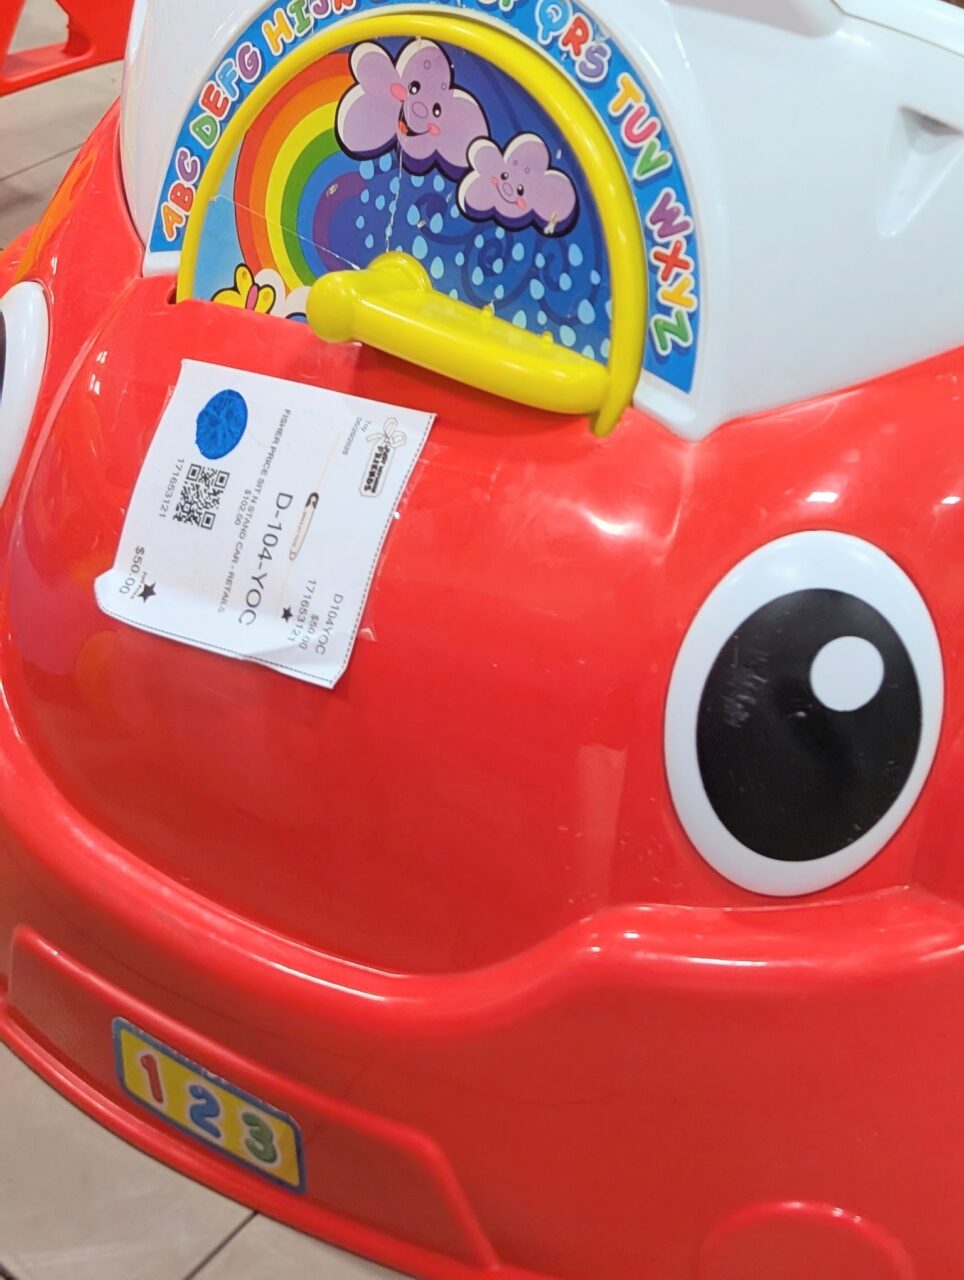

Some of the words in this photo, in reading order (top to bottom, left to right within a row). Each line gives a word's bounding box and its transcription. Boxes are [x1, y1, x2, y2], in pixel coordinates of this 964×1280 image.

[272, 409, 291, 444] FISHER
[159, 459, 184, 518] 171653121
[260, 446, 277, 476] PRICE
[119, 546, 145, 598] $50.00
[232, 541, 243, 564] CAR
[239, 492, 293, 625] D-104-YOC
[287, 580, 317, 641] 171653121
[315, 593, 344, 655] D104YOC
